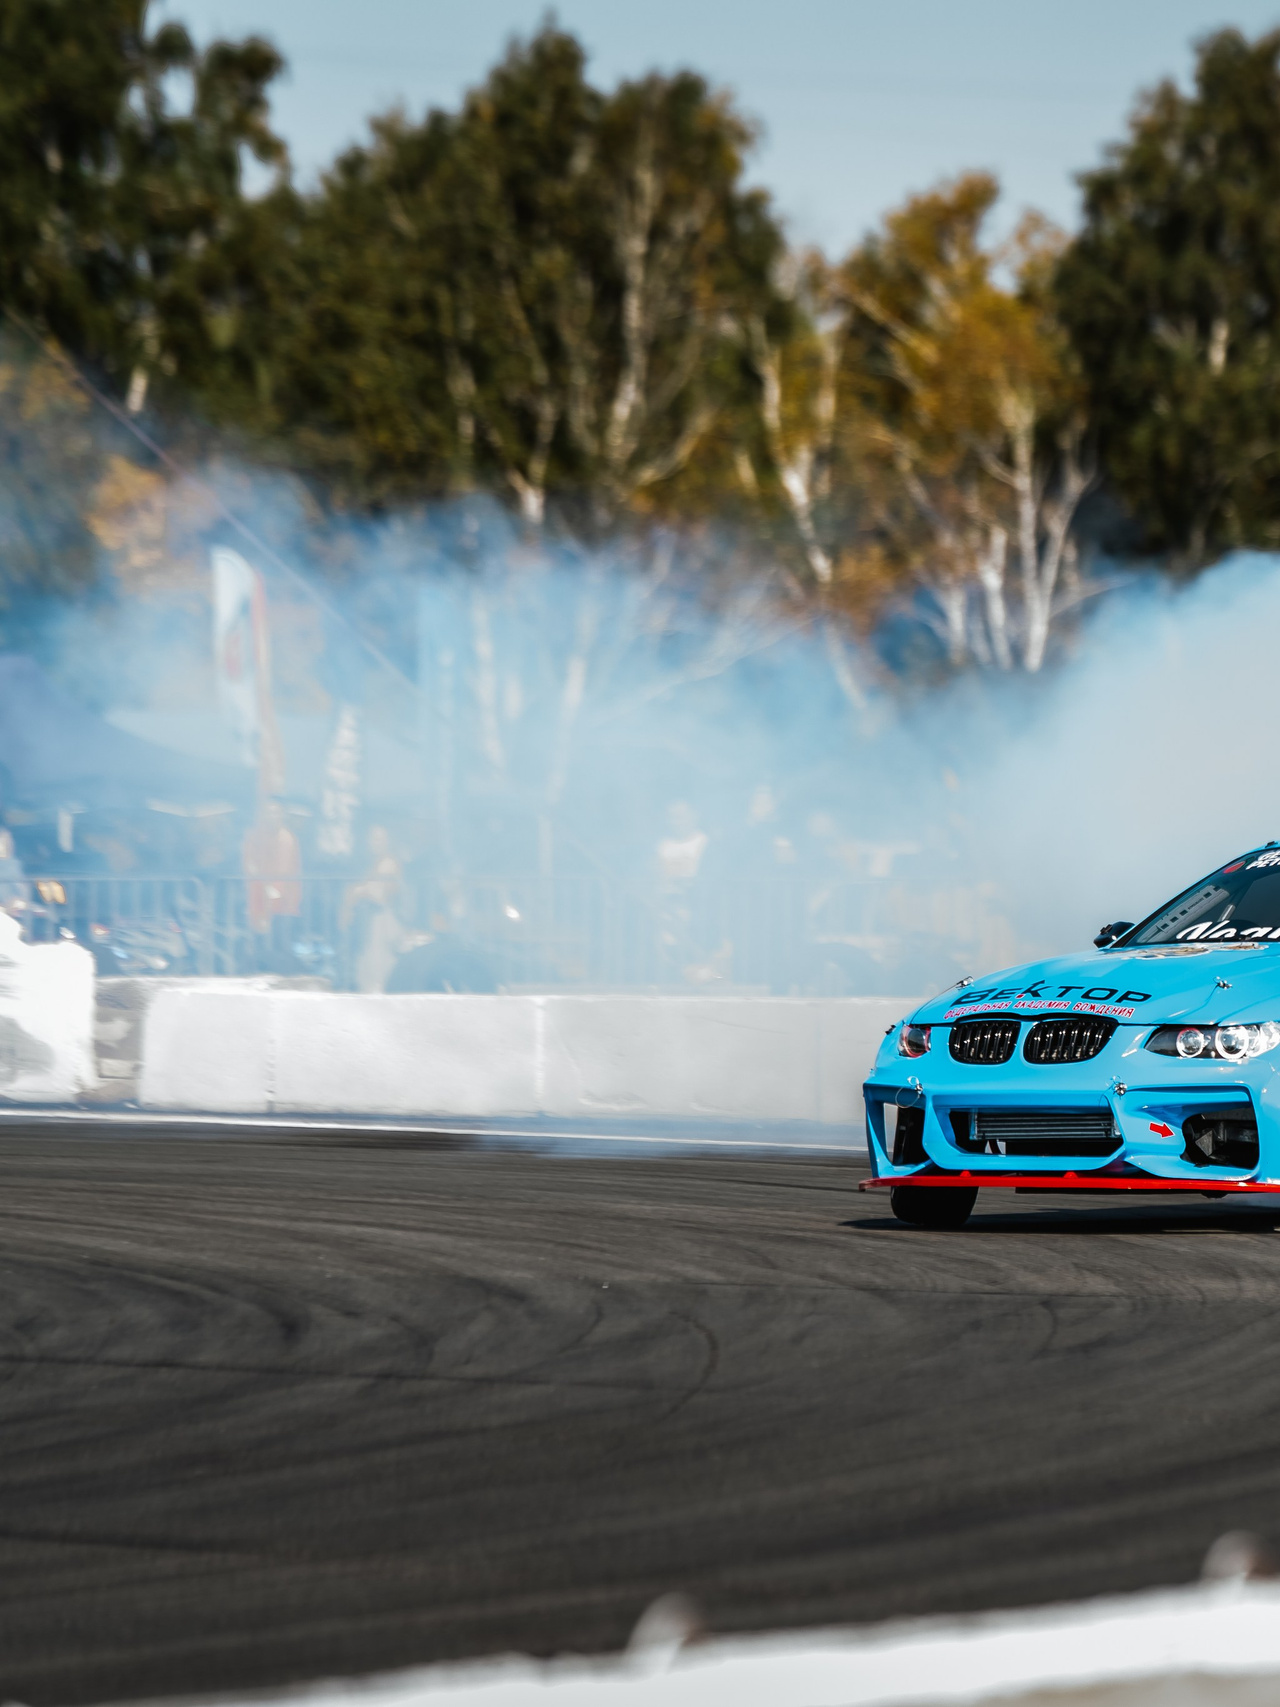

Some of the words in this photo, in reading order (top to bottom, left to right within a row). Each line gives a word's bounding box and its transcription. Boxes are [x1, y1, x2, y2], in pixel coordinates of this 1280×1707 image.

[950, 980, 1152, 1007] ВЕКТОР
[944, 1001, 1012, 1019] ФЕДЕРАЛЬНАЯ
[1013, 1000, 1071, 1010] АКАДЕМИЯ
[1072, 1002, 1135, 1018] ВОЖДЕНИЯ
